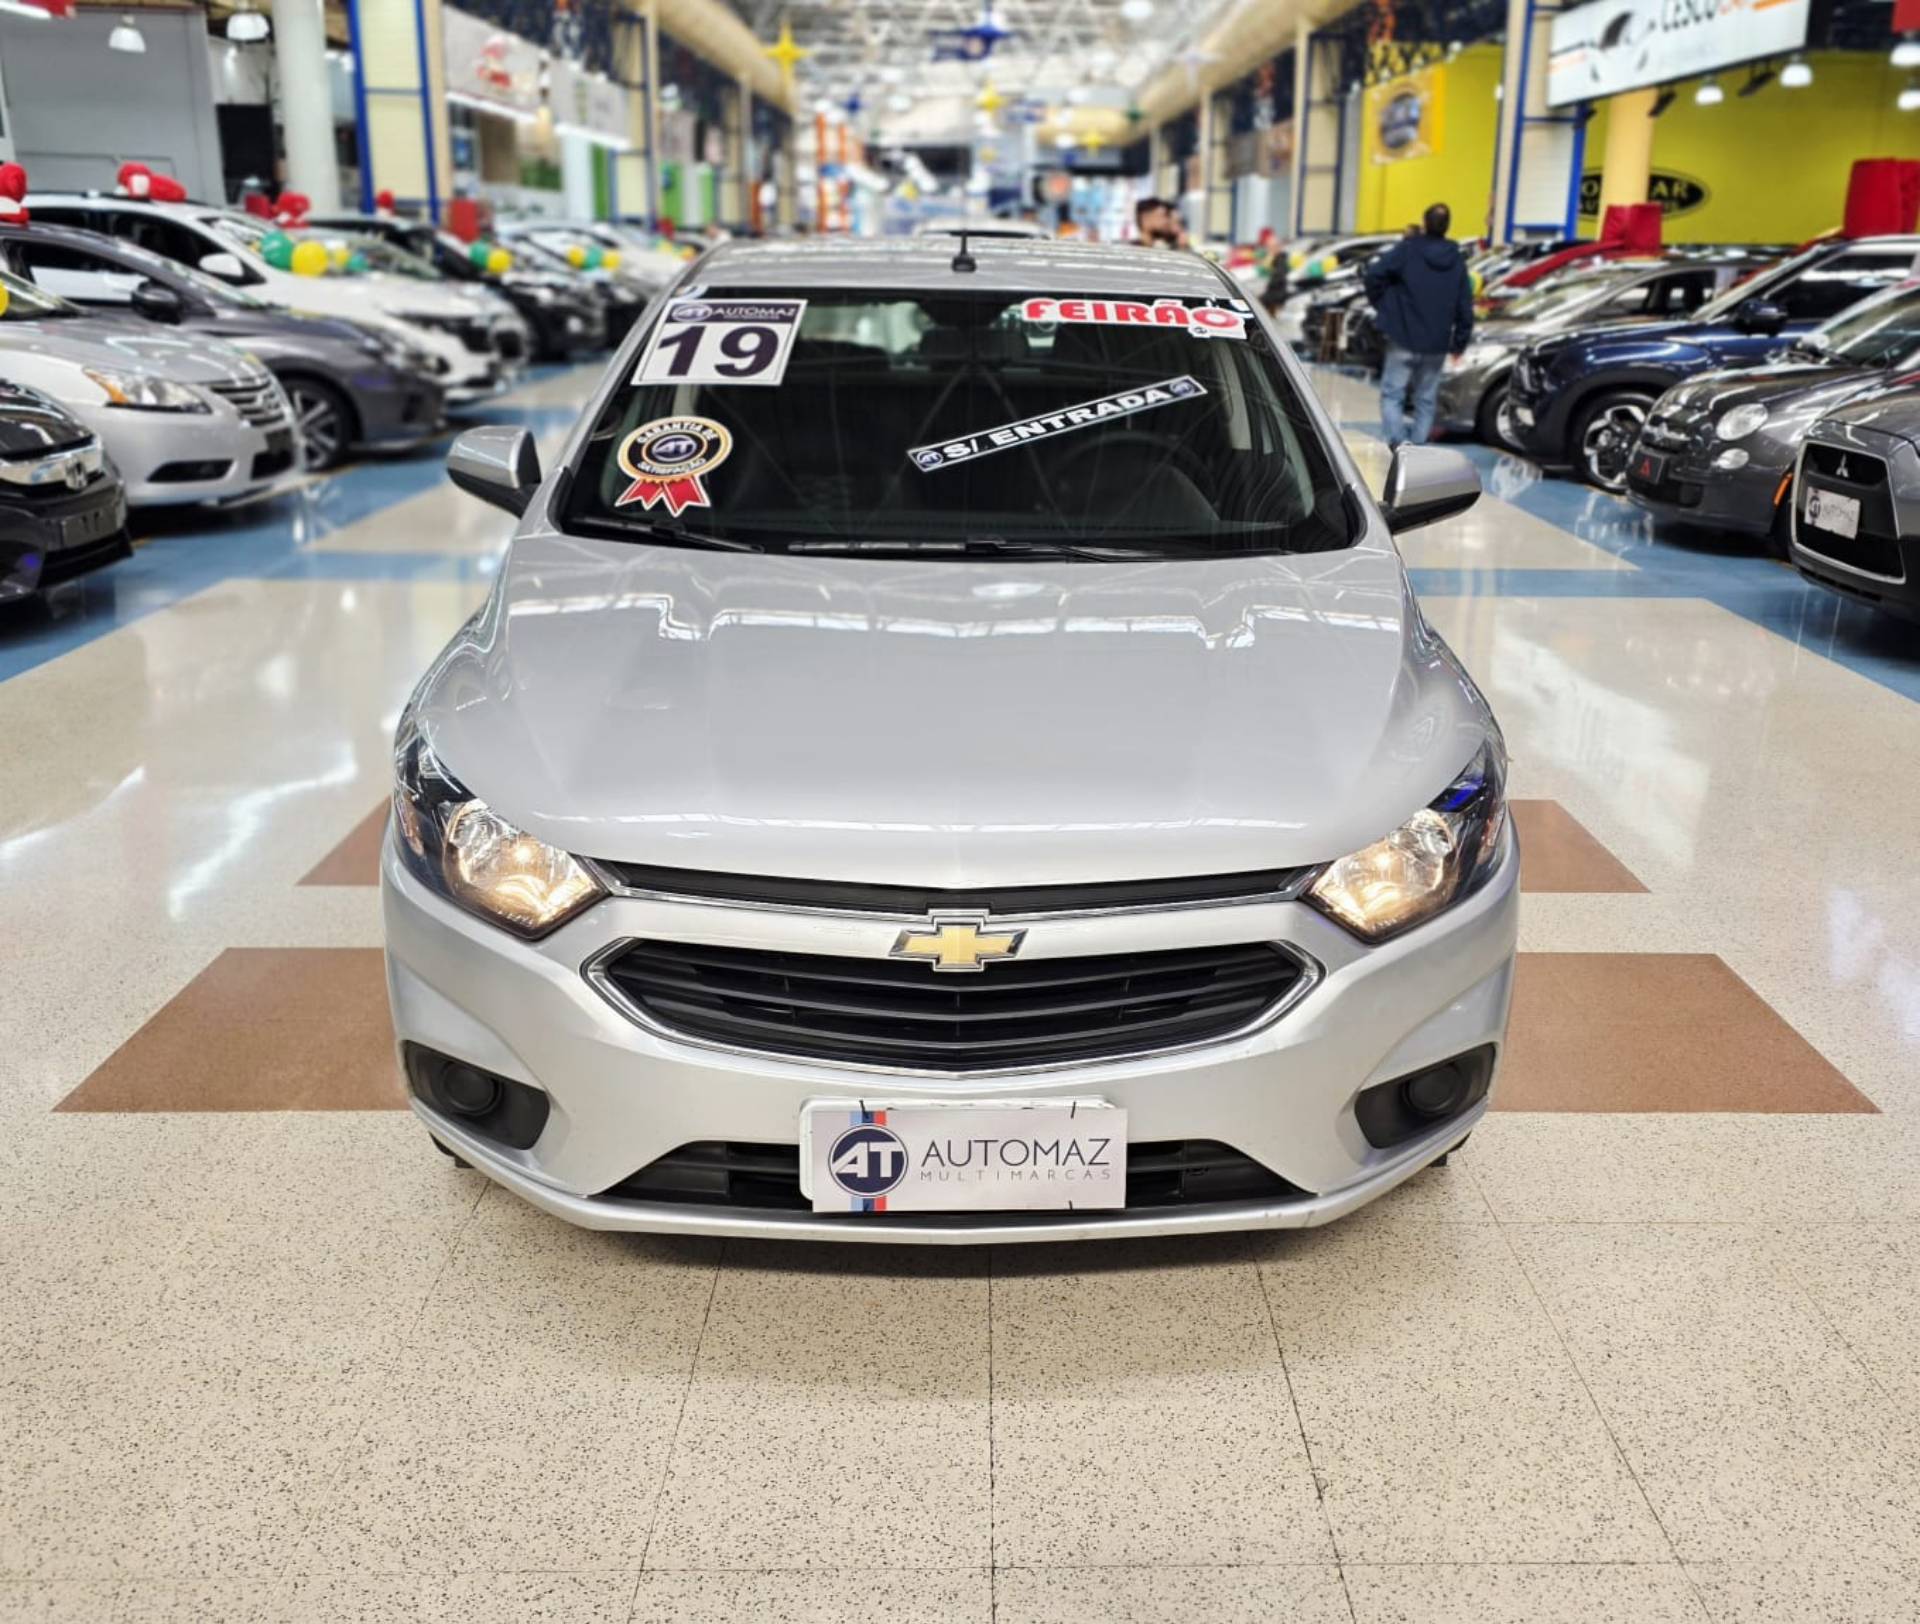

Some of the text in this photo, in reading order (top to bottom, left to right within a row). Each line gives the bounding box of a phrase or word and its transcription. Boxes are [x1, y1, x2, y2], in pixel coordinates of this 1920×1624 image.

[712, 306, 796, 317] AUTOMAZ
[1026, 300, 1240, 329] FEIRÃO
[658, 325, 779, 378] 19
[942, 388, 1173, 460] S/ ENTRADA
[832, 1141, 905, 1180] AT
[920, 1138, 1112, 1168] AUTOMAZ
[920, 1169, 1111, 1182] MULTIMARCAS
